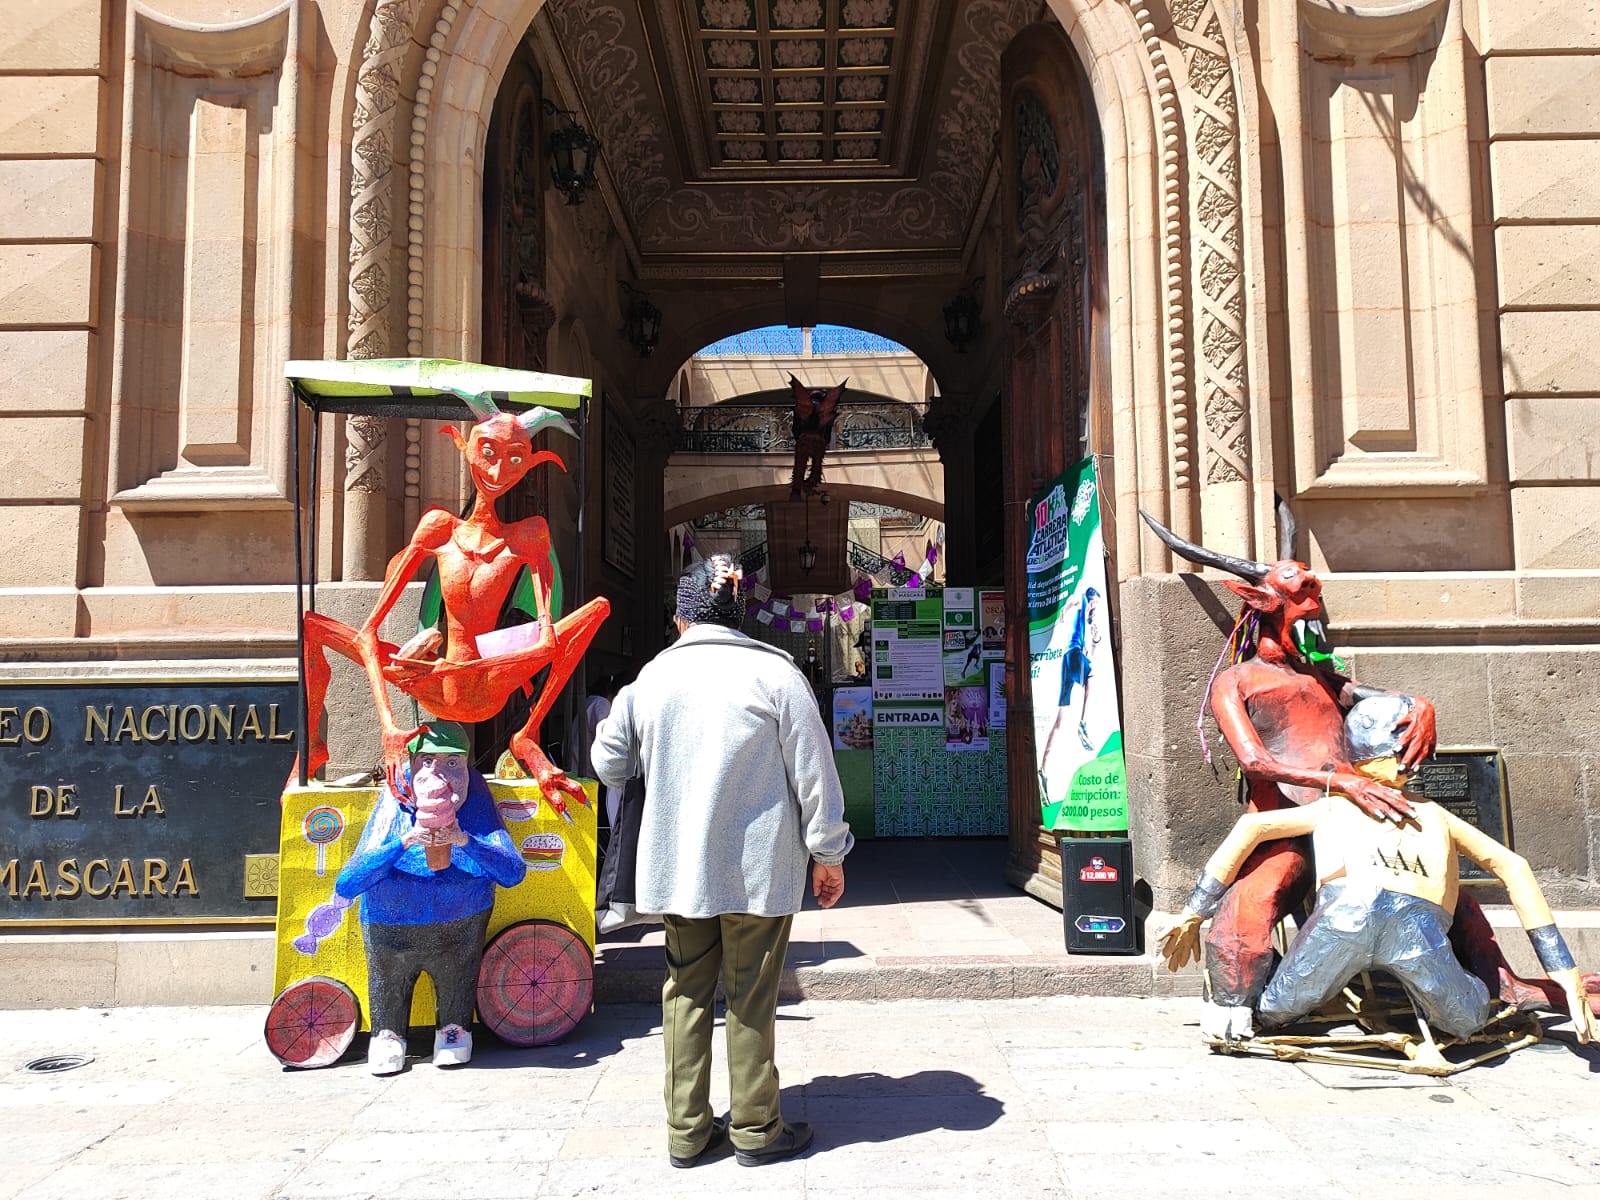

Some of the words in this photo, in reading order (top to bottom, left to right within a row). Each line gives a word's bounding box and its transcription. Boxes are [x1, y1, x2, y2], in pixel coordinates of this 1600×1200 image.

[1035, 514, 1067, 543] CARRERA
[84, 703, 295, 743] NACIONAL
[877, 712, 940, 723] ENTRADA
[1078, 774, 1102, 786] Costo
[1104, 772, 1120, 785] de
[30, 785, 79, 816] DE
[114, 784, 165, 816] LA
[1062, 805, 1089, 818] $200.00
[1090, 807, 1124, 821] pesos
[0, 858, 199, 898] MASCARA
[1086, 871, 1107, 880] 12,000
[1107, 871, 1116, 880] W
